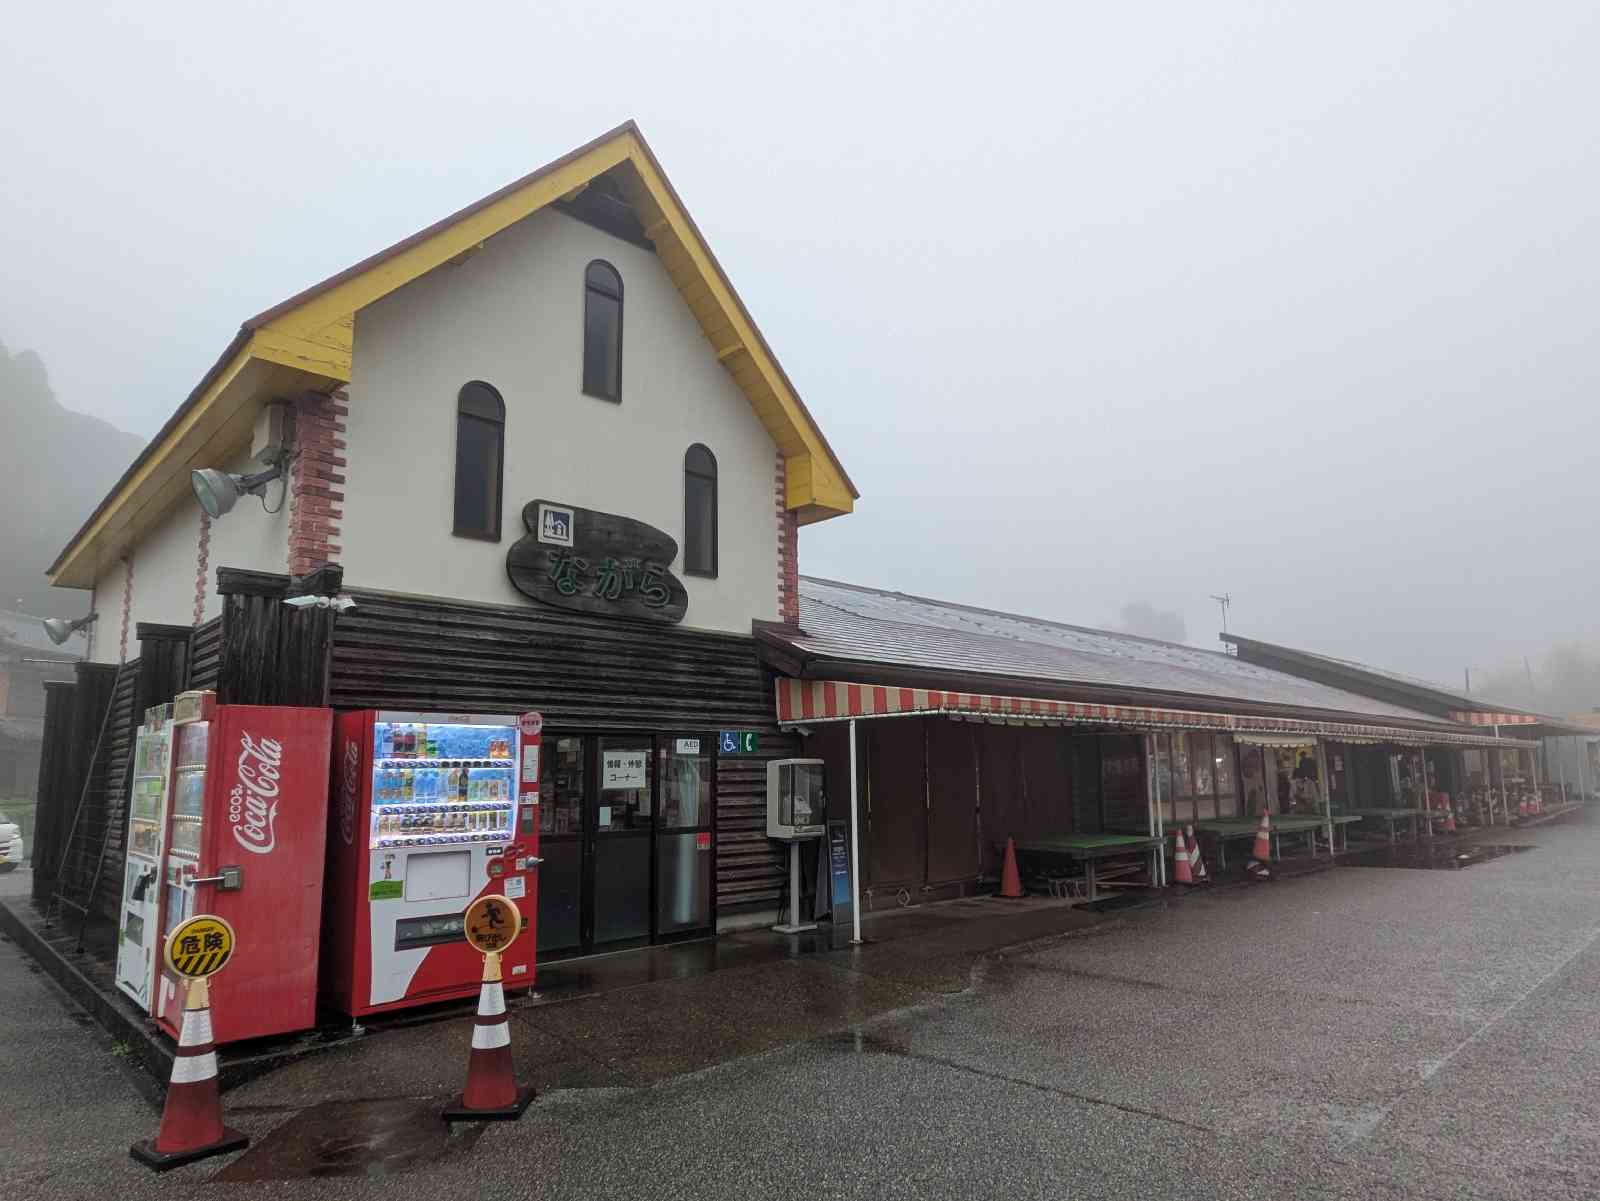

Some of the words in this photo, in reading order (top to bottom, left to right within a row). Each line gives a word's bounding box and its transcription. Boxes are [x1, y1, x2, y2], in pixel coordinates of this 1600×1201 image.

[549, 550, 671, 608] ながら
[609, 773, 639, 782] コーナー
[180, 932, 224, 955] 危険
